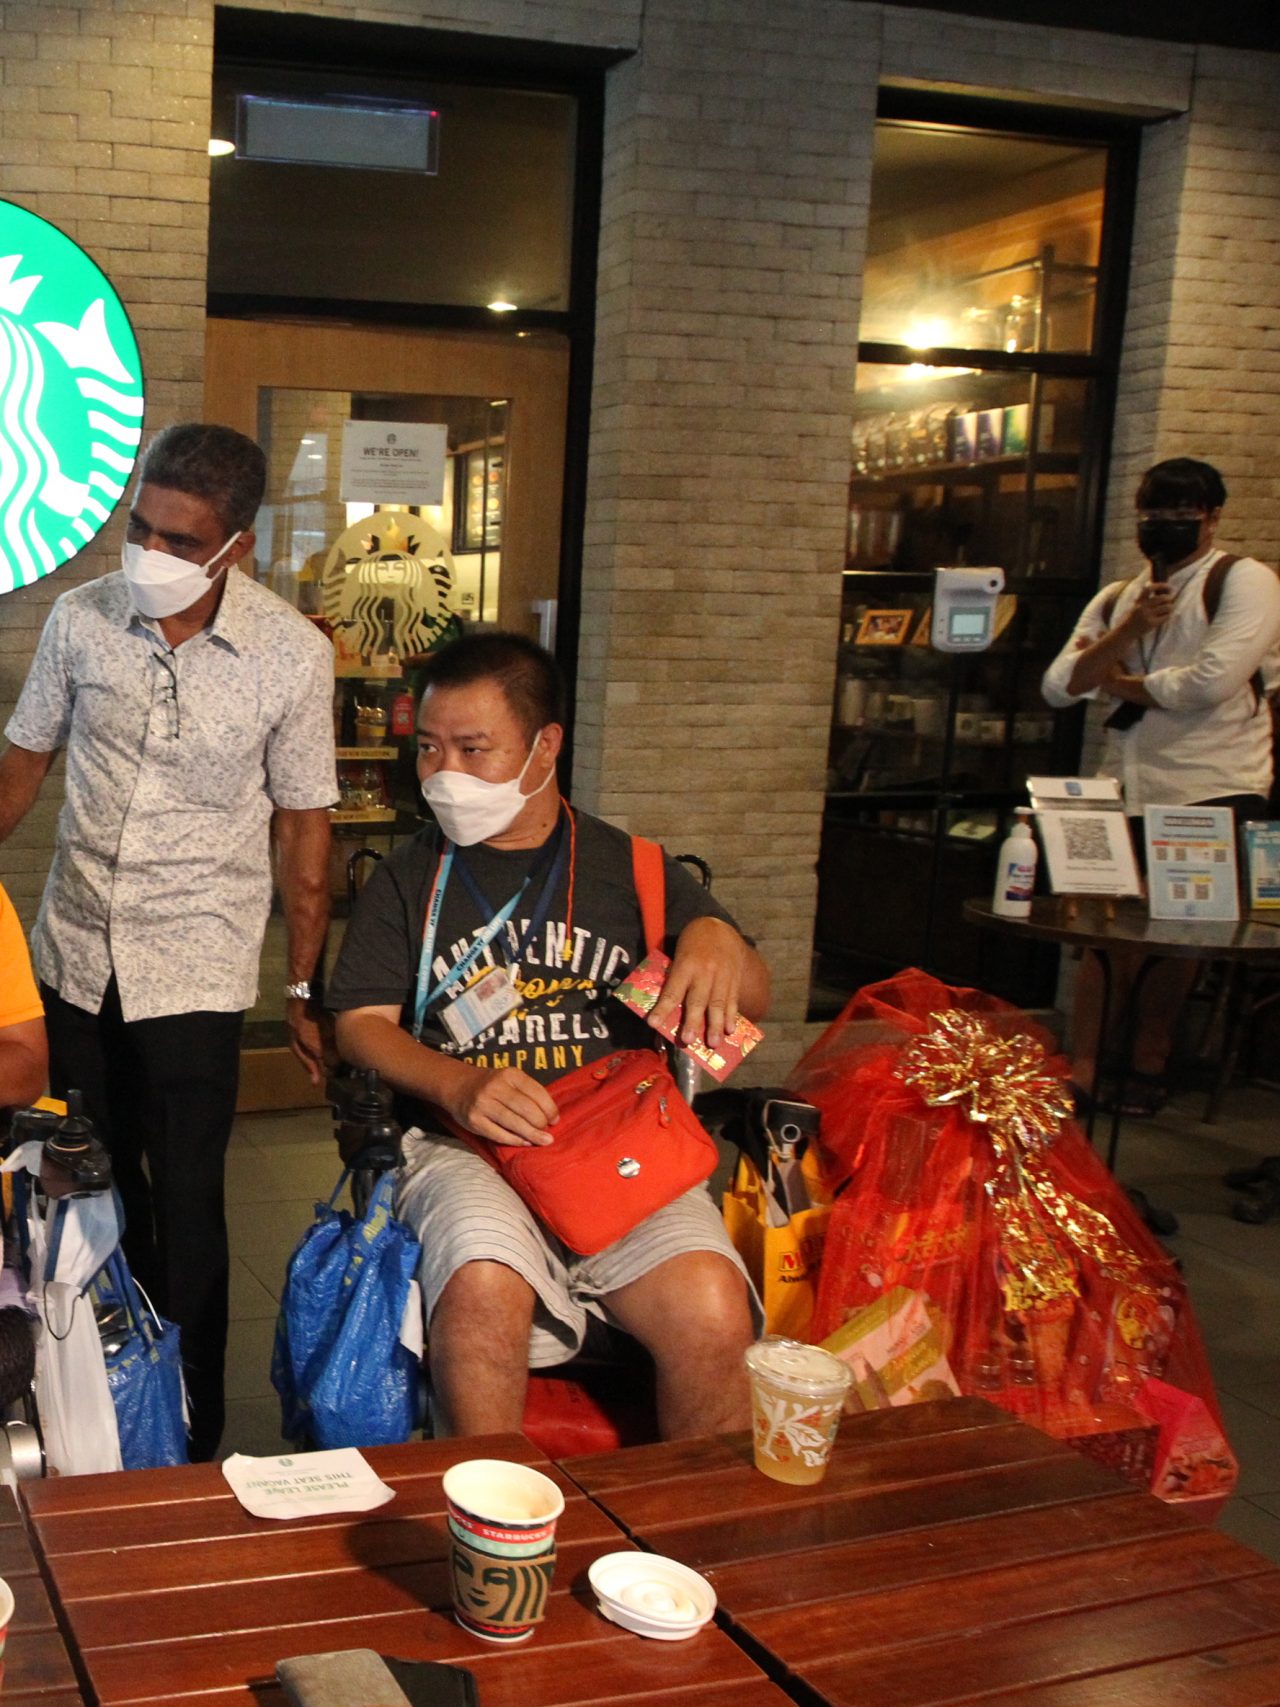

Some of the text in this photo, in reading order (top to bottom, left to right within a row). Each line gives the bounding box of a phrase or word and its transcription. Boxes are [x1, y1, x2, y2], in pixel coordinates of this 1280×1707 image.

[363, 447, 390, 457] WE'RE
[246, 1472, 352, 1489] THIS SEAT VACANT
[302, 1481, 349, 1494] PLEASE
[482, 1528, 547, 1541] STARBUCKS
